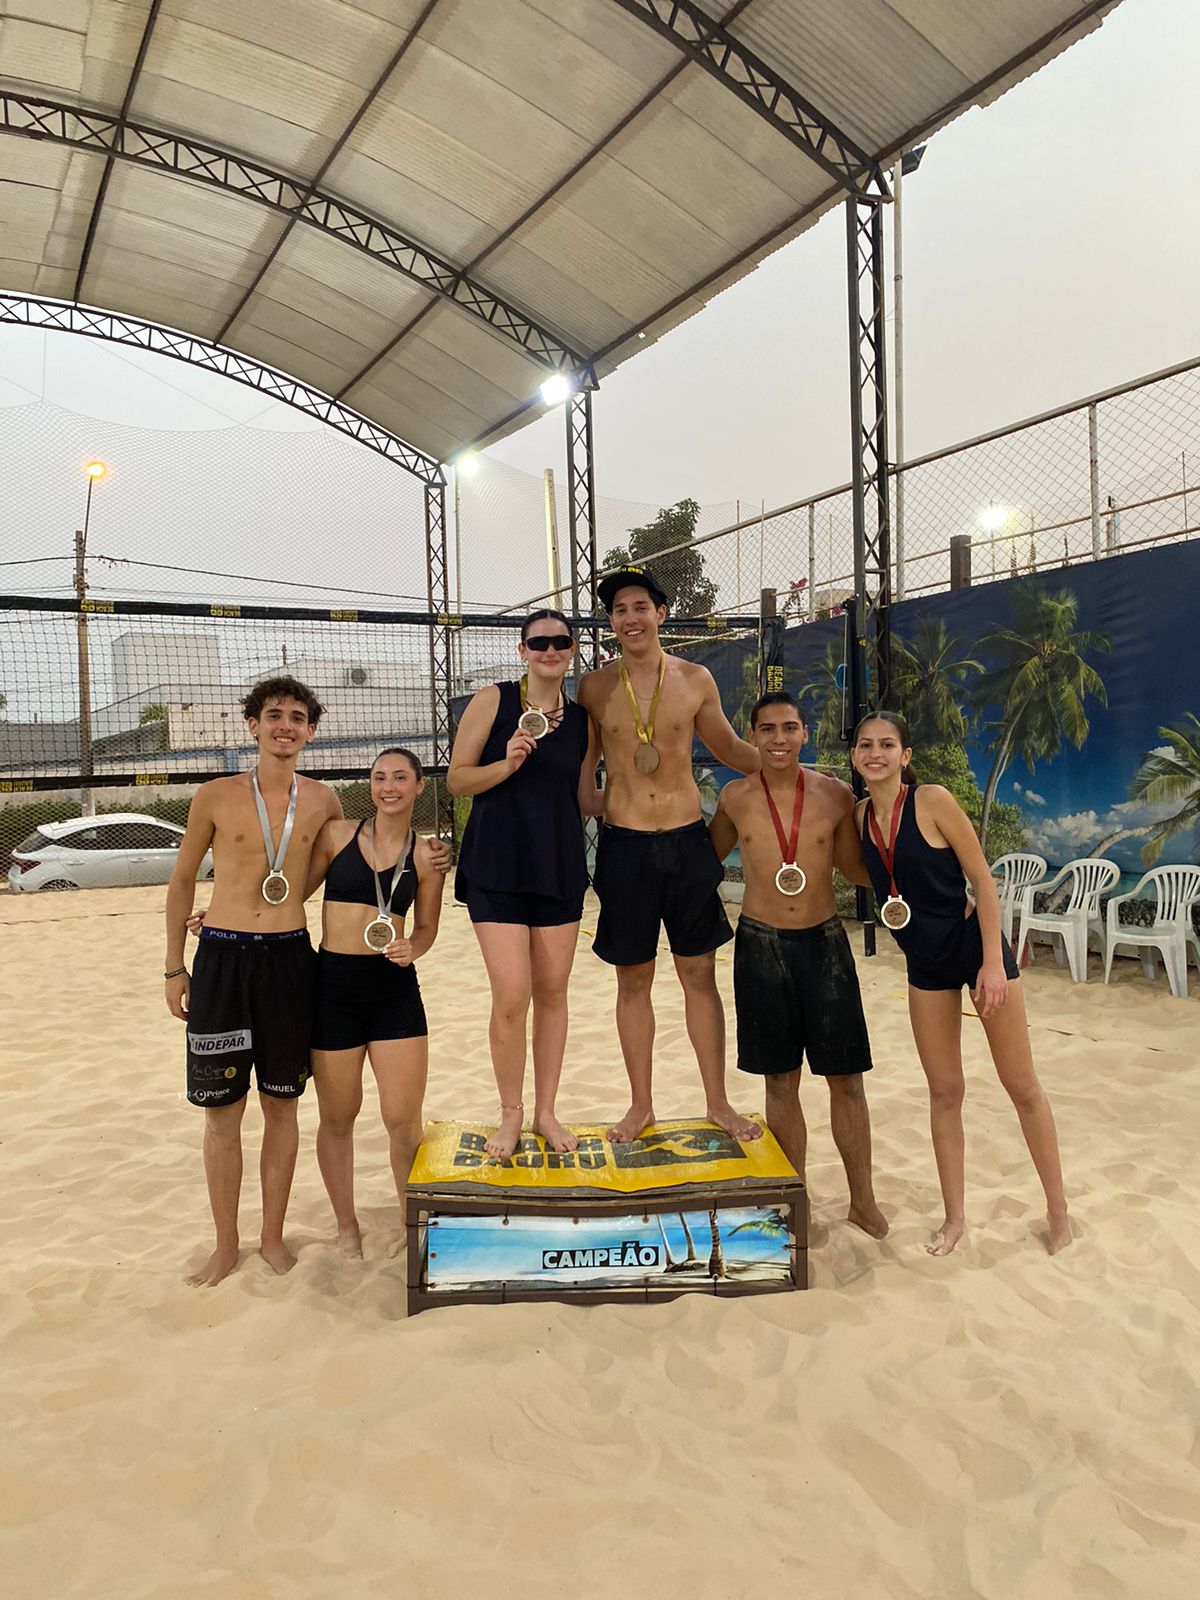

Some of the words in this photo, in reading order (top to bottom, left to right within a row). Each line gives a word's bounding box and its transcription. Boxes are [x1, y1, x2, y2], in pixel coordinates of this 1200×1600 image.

[774, 665, 783, 692] BEACH
[209, 930, 238, 940] POLO
[195, 1036, 246, 1052] INDEPAR
[262, 1081, 296, 1093] SAMUEL
[458, 1131, 604, 1154] BAH
[453, 1150, 608, 1170] BAURU
[543, 1242, 657, 1269] CAMPEÃO
